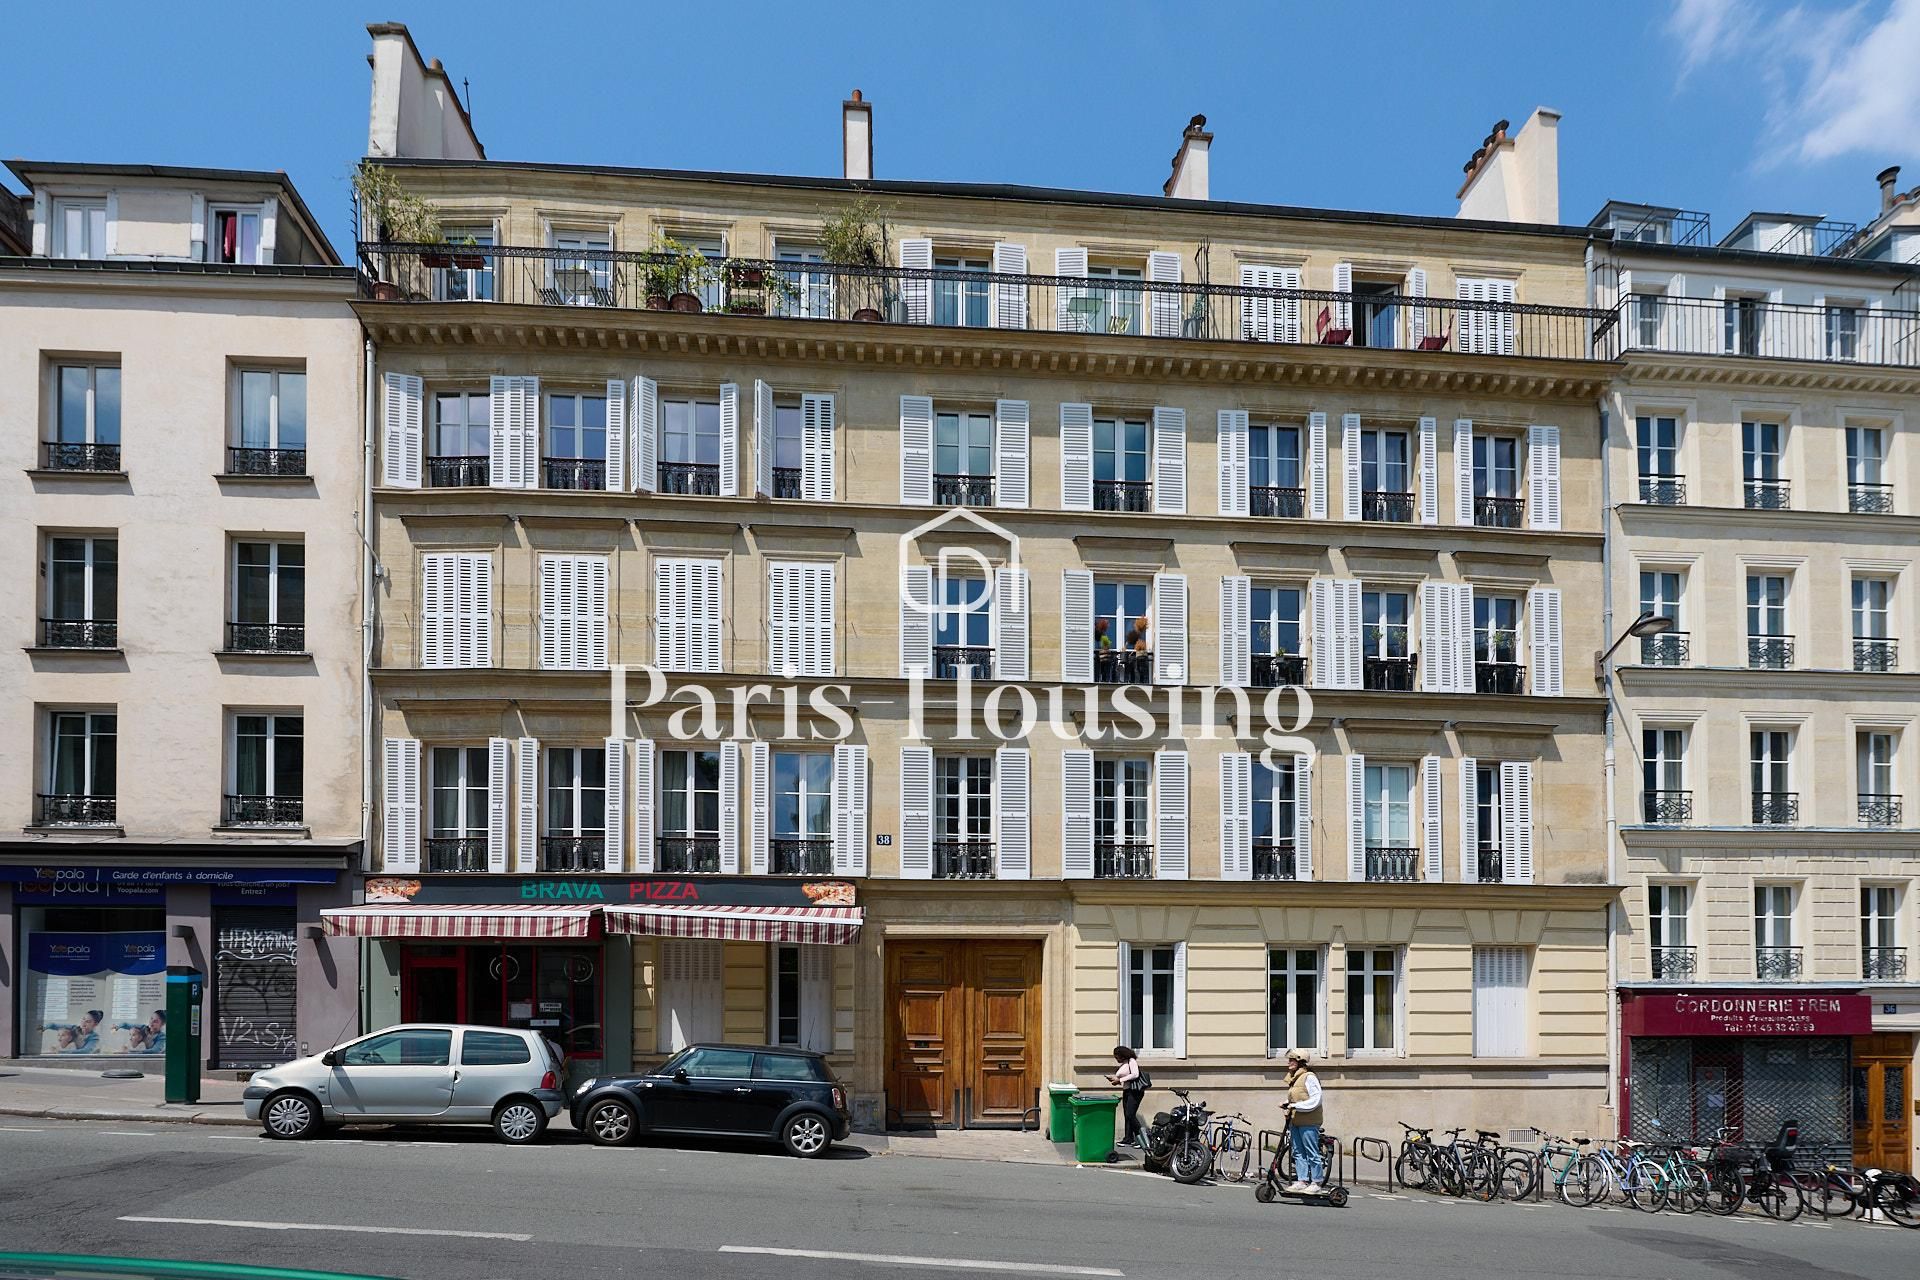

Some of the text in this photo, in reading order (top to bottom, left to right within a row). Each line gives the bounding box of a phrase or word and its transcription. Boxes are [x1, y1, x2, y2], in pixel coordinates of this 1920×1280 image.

[878, 836, 890, 844] 38
[112, 870, 139, 880] Garde
[142, 870, 183, 880] d'enfants
[195, 871, 234, 880] domicile
[520, 880, 699, 899] BRAVA PIZZA
[1675, 998, 1841, 1013] CORDONNERIE TREM
